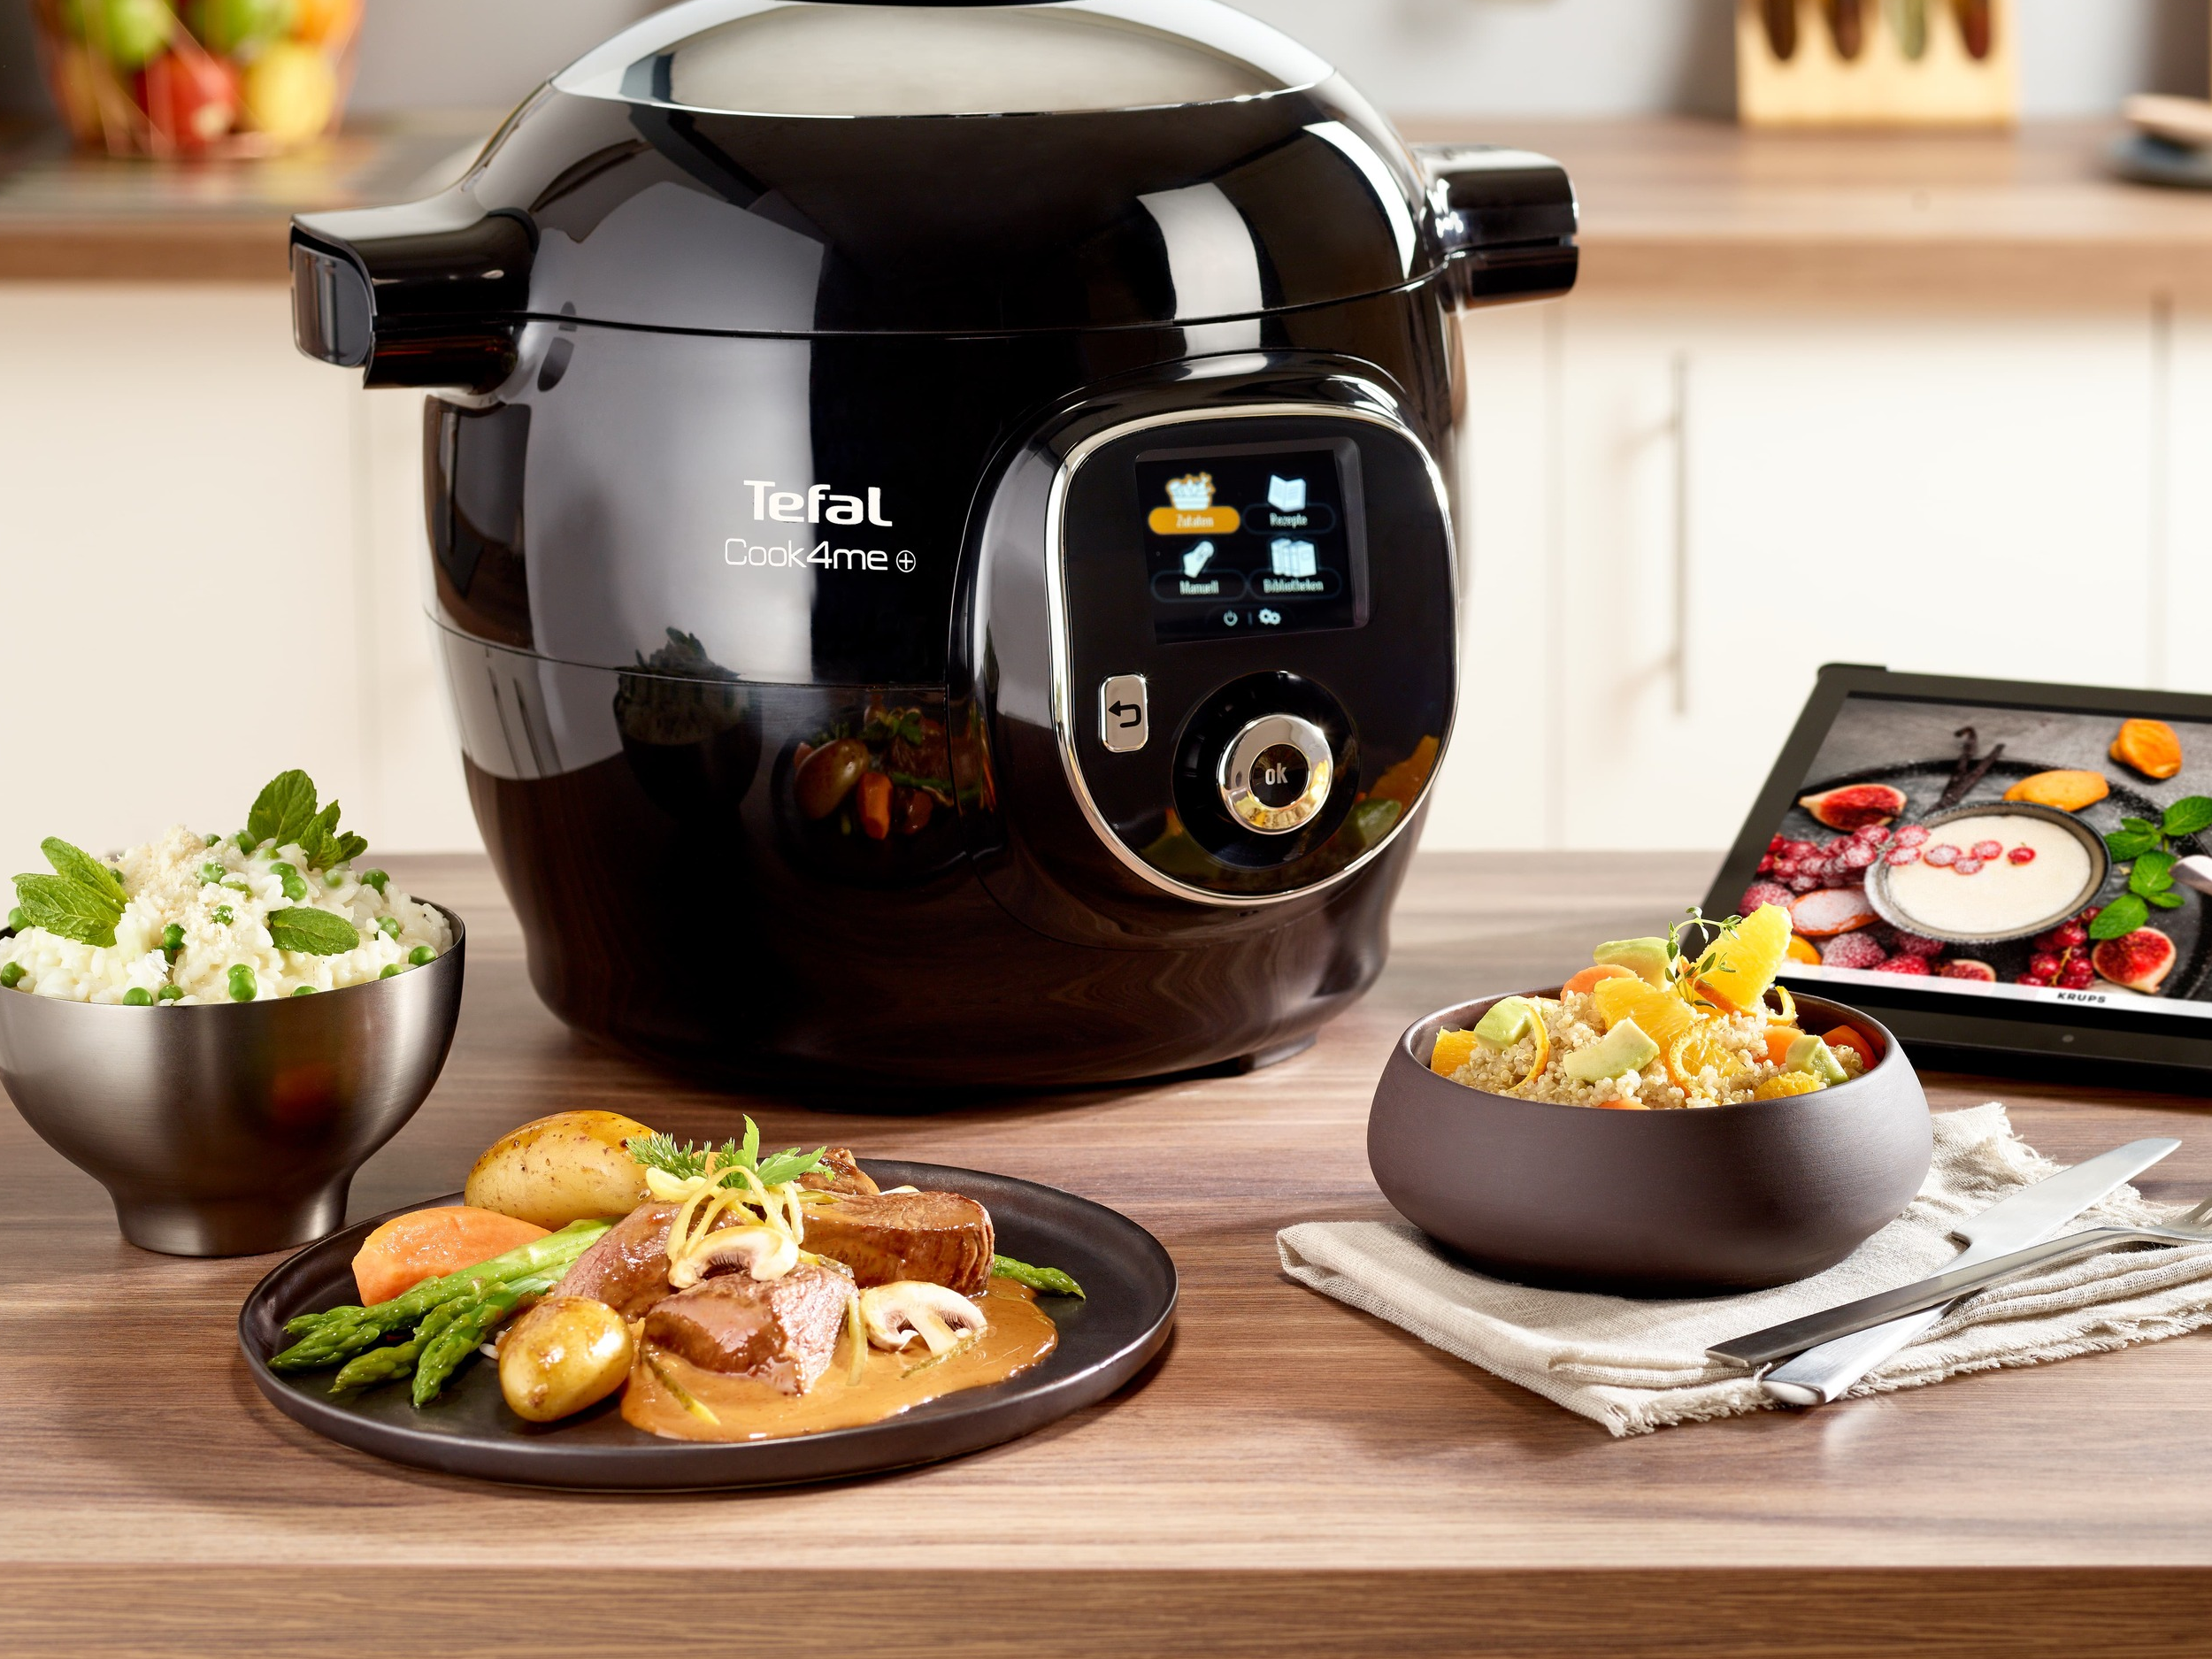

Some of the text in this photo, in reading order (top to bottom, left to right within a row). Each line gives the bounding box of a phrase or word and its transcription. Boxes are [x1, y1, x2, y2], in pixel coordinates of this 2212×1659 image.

[743, 480, 893, 527] Tefal
[1176, 514, 1214, 528] Zutaten
[1270, 512, 1308, 529] Rezepte
[1179, 580, 1219, 595] Manuell
[1263, 579, 1324, 594] Bibliotheken
[2057, 992, 2106, 1003] KRUPS
